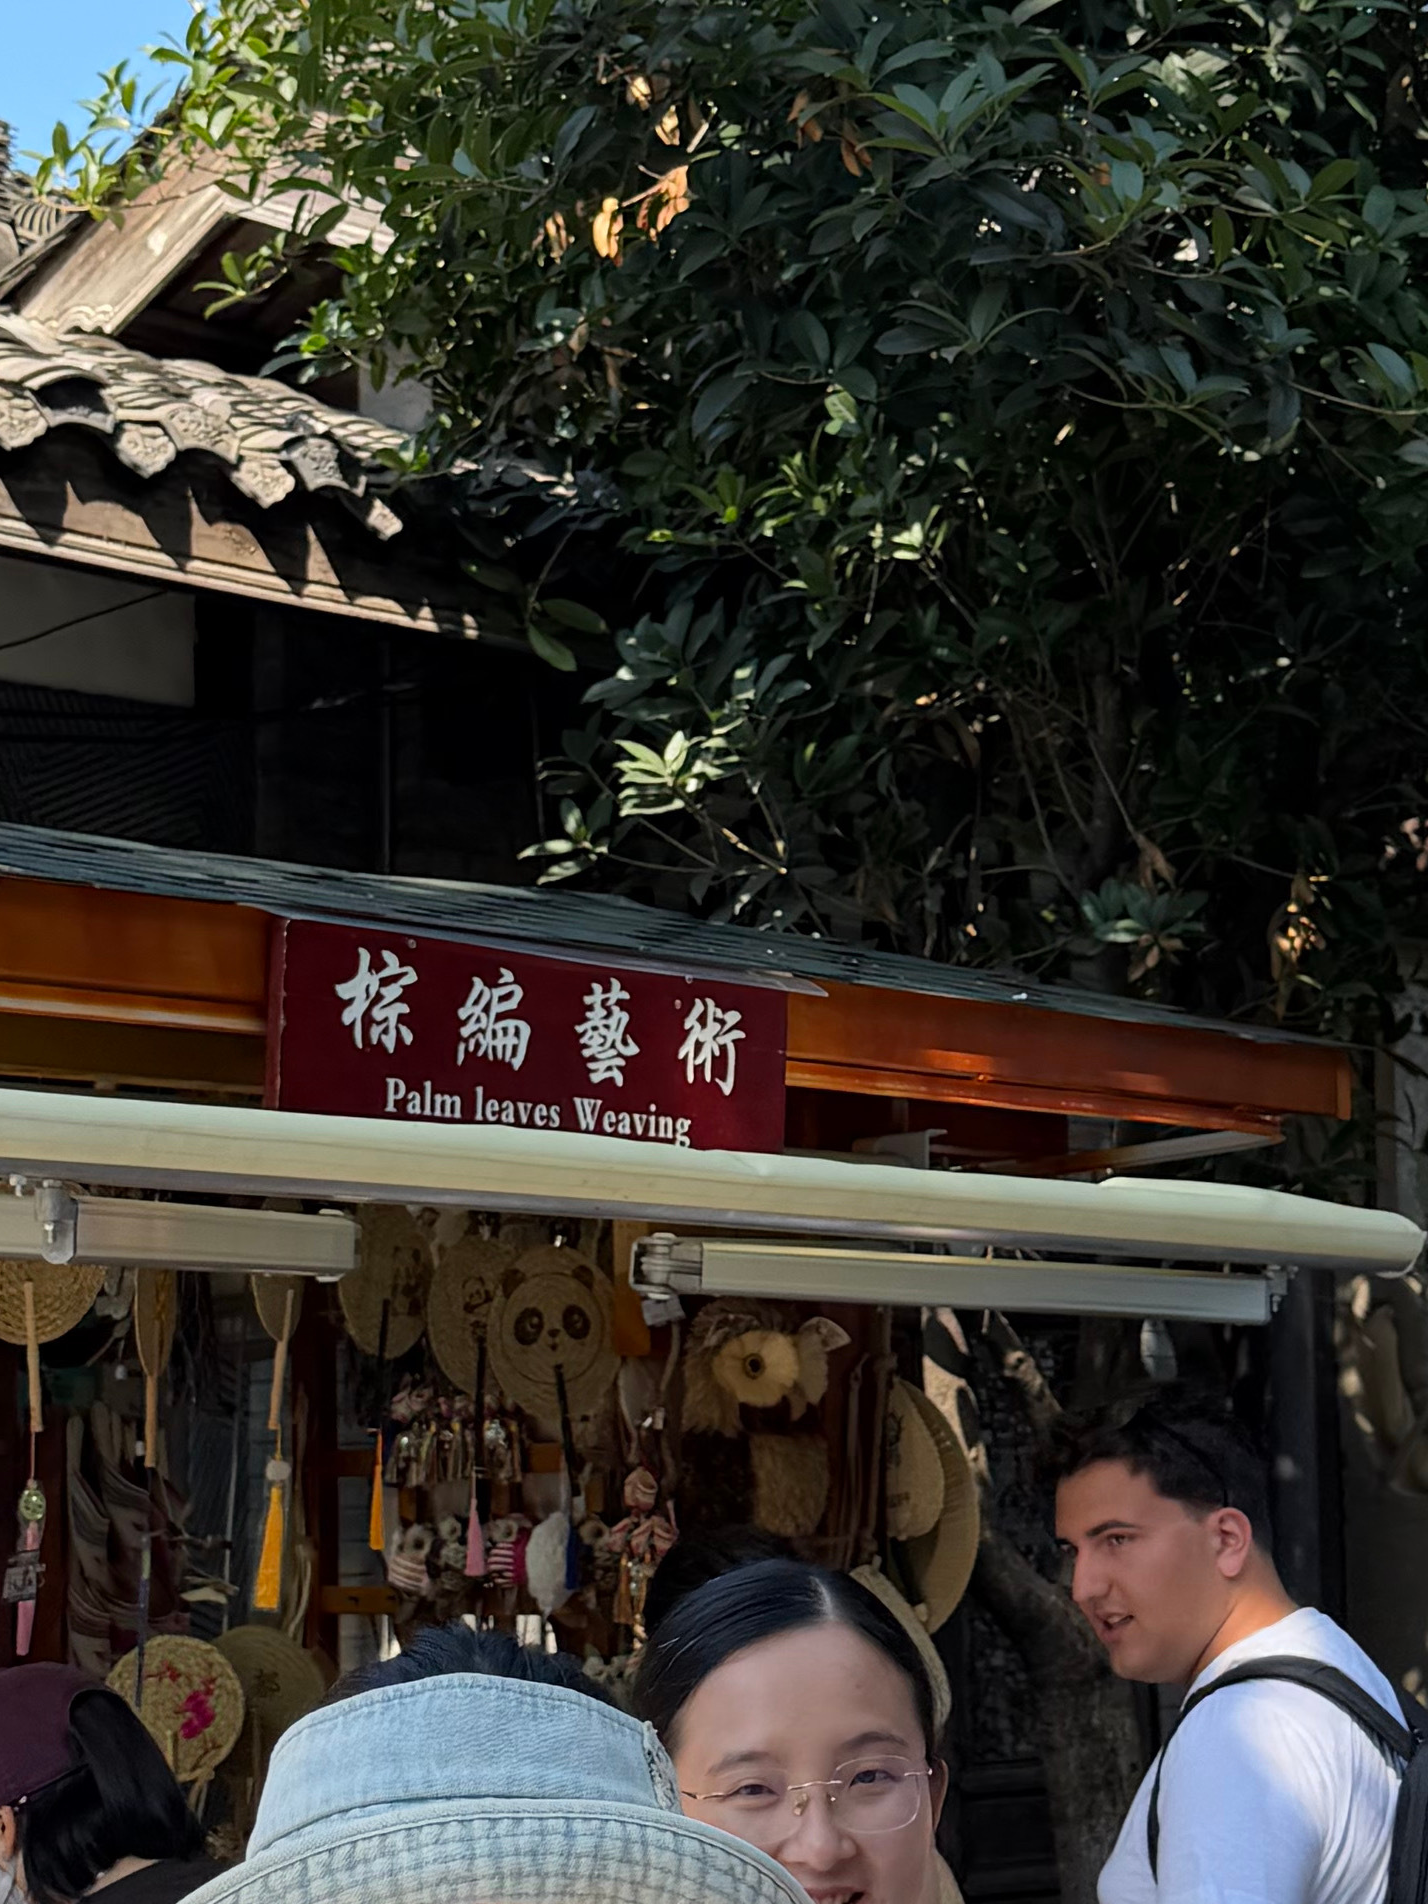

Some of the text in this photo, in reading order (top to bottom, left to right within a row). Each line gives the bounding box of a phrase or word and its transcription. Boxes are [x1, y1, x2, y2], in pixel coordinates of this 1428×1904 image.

[334, 946, 747, 1096] 棕編藝術
[383, 1077, 693, 1148] Palm leaves Weaving
